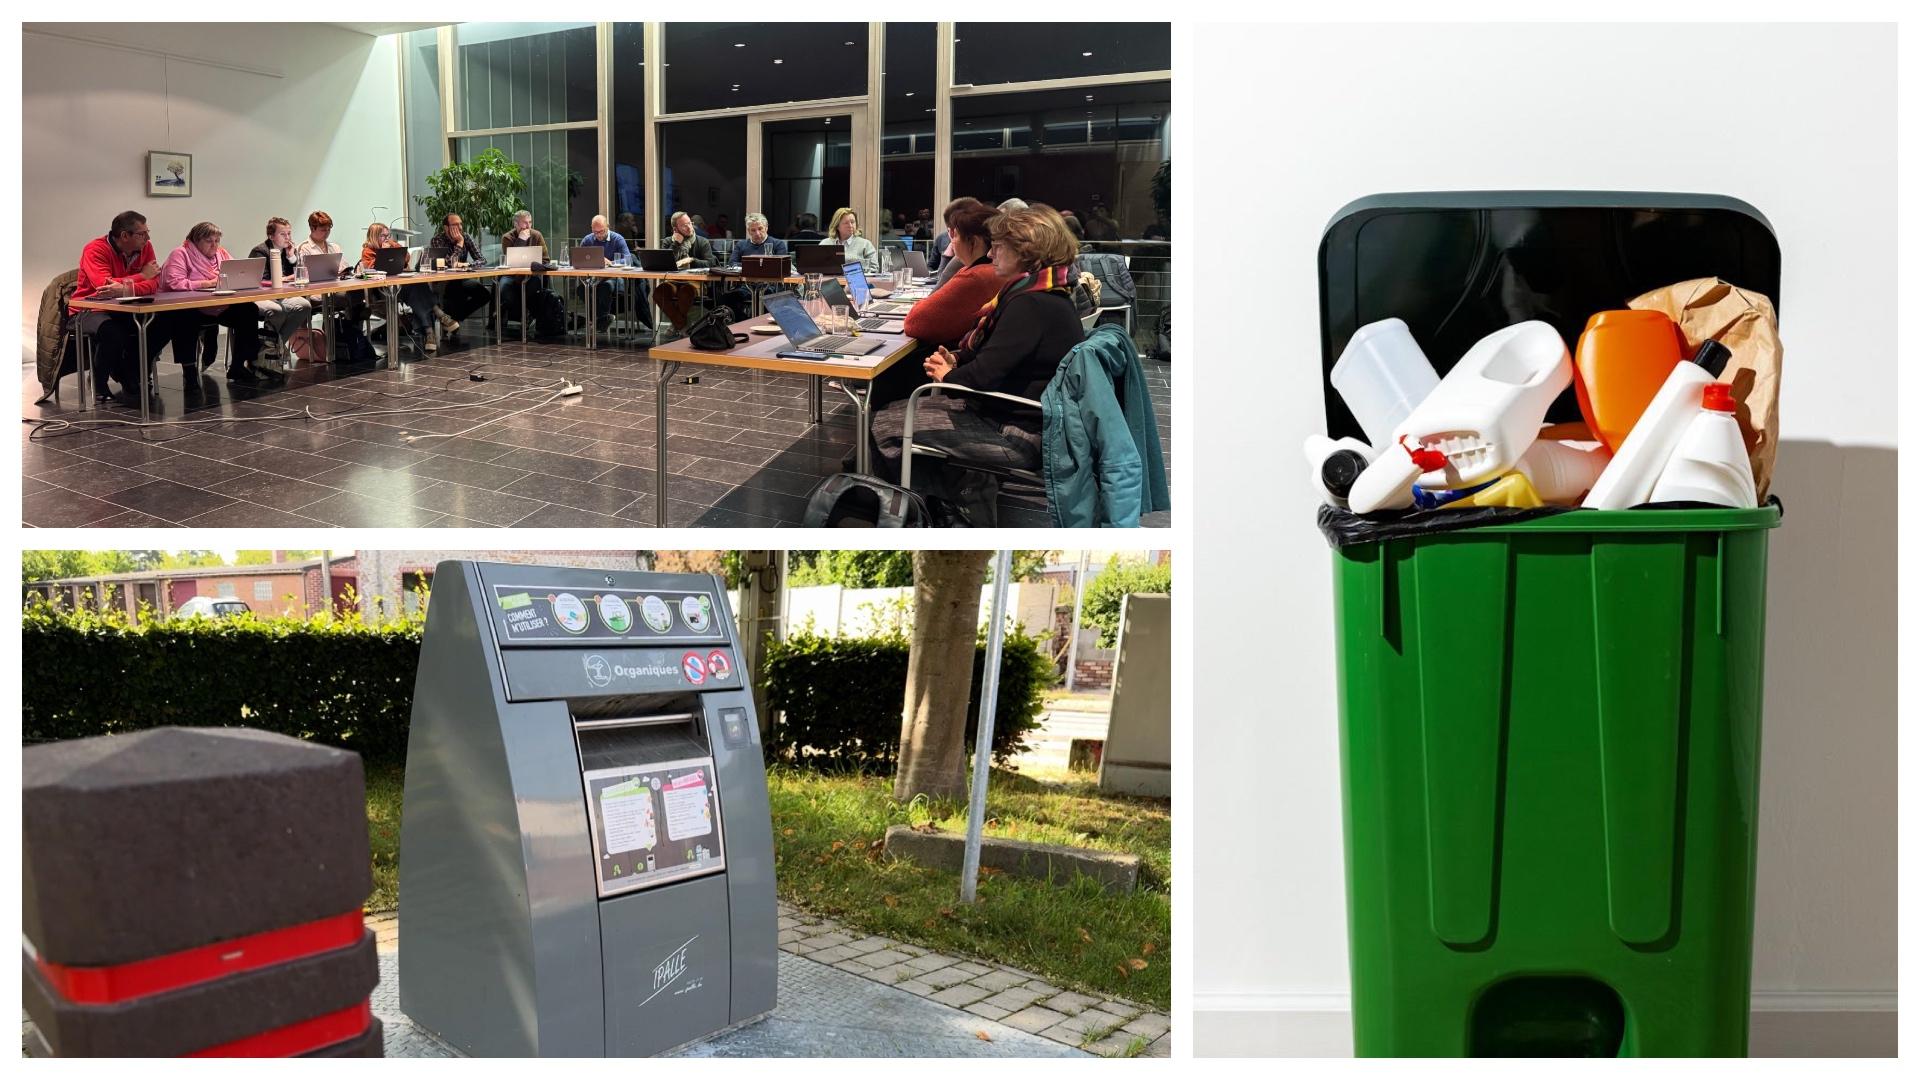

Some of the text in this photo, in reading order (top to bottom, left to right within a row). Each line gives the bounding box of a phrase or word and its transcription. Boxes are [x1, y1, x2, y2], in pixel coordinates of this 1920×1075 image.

[507, 608, 537, 623] COMMENT
[614, 664, 679, 678] Organiques
[653, 948, 687, 990] IPALLE
